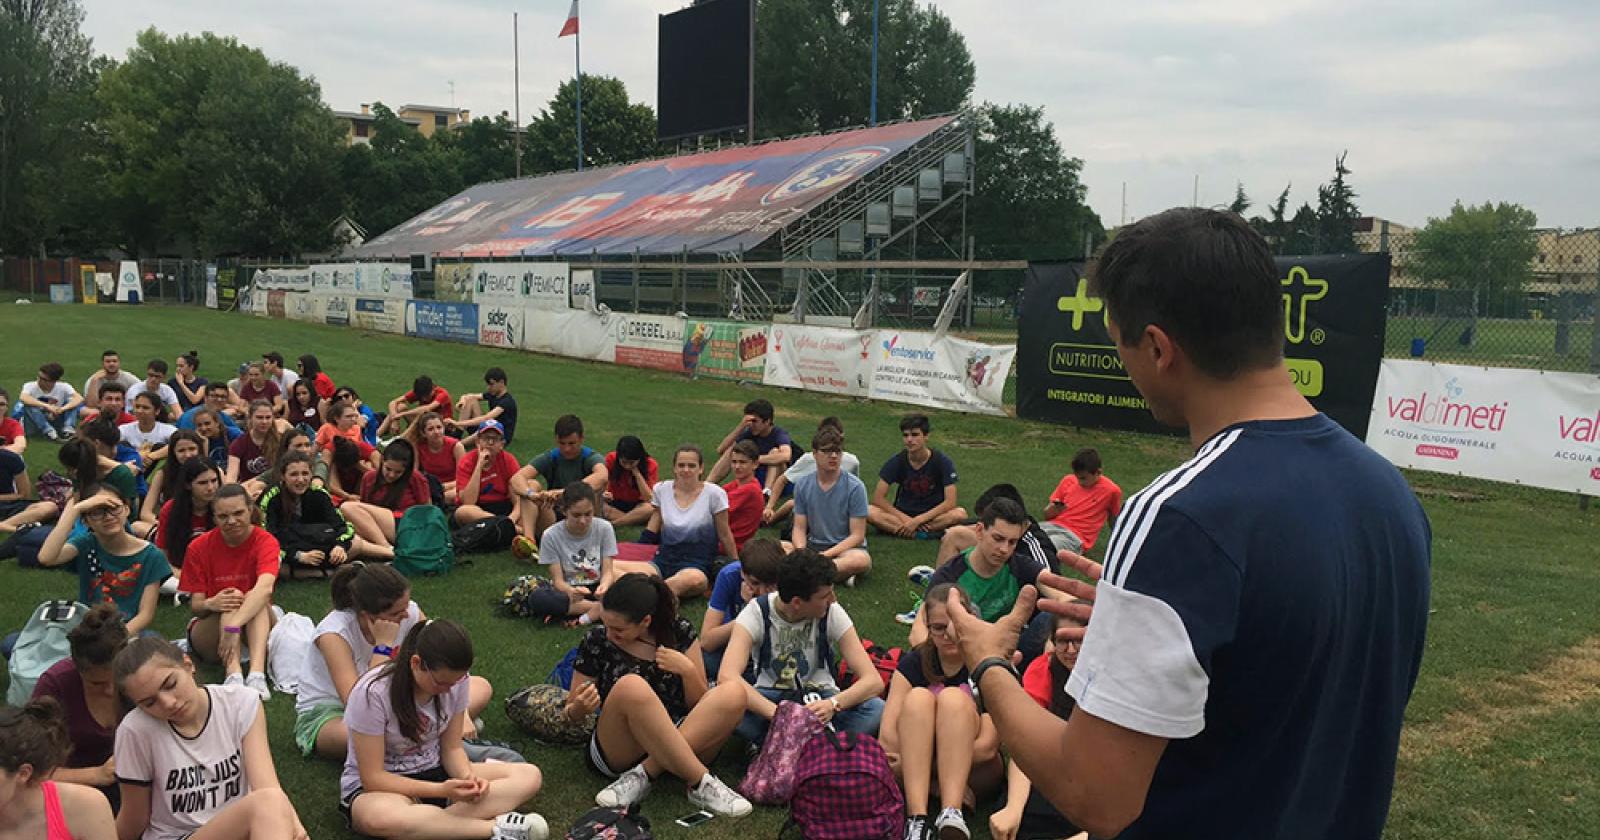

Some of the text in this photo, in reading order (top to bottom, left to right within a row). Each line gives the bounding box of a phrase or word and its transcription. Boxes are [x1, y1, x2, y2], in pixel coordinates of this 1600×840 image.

[1287, 368, 1311, 386] OU
[1047, 388, 1105, 405] INTEGRATORI
[1387, 391, 1508, 432] valdimeti
[1559, 409, 1600, 443] val
[1384, 428, 1496, 450] ACQUA OLIGOMINERALE
[1554, 450, 1593, 462] ACQUA
[166, 749, 240, 791] BASIC JUS
